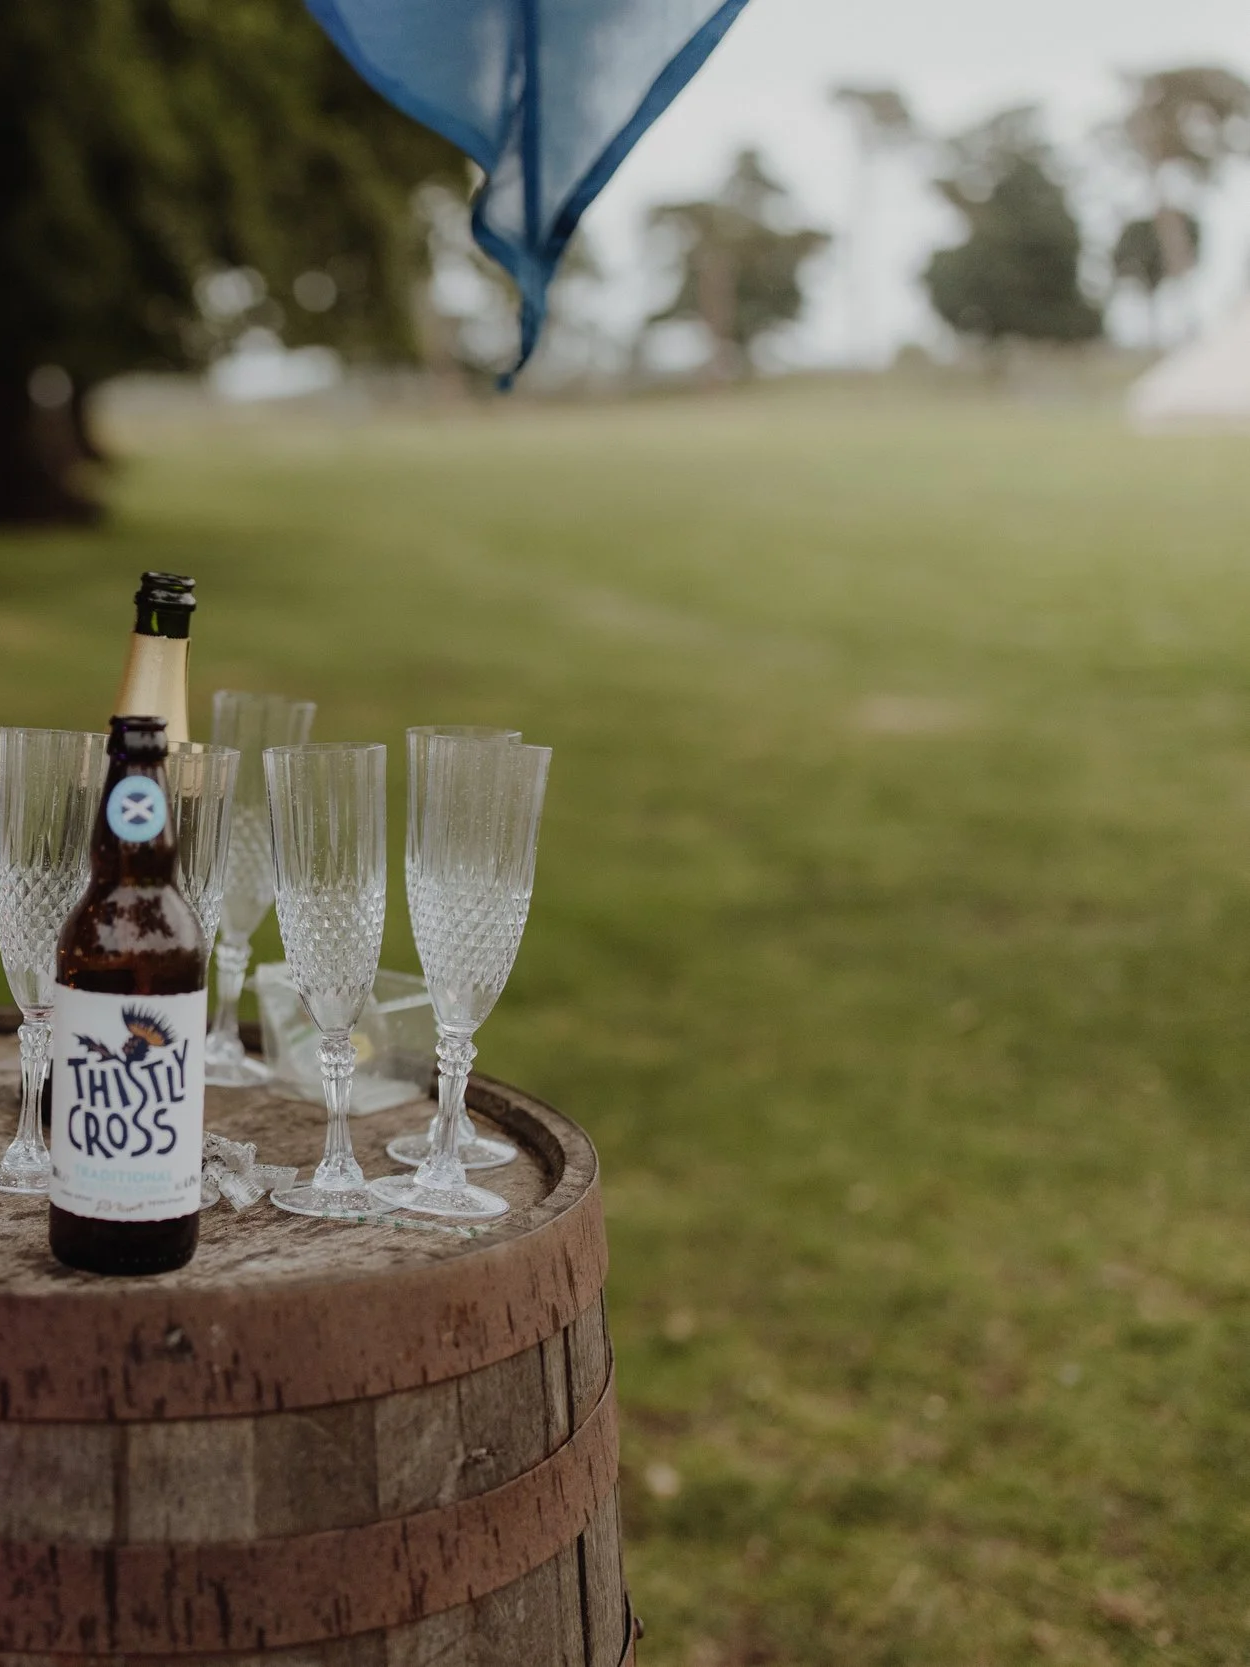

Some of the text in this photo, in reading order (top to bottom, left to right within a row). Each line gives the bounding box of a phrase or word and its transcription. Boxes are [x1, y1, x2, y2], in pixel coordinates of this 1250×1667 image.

[68, 1038, 188, 1108] THISTLY
[68, 1104, 177, 1159] CROSS
[74, 1164, 172, 1183] TRADITIONAL
